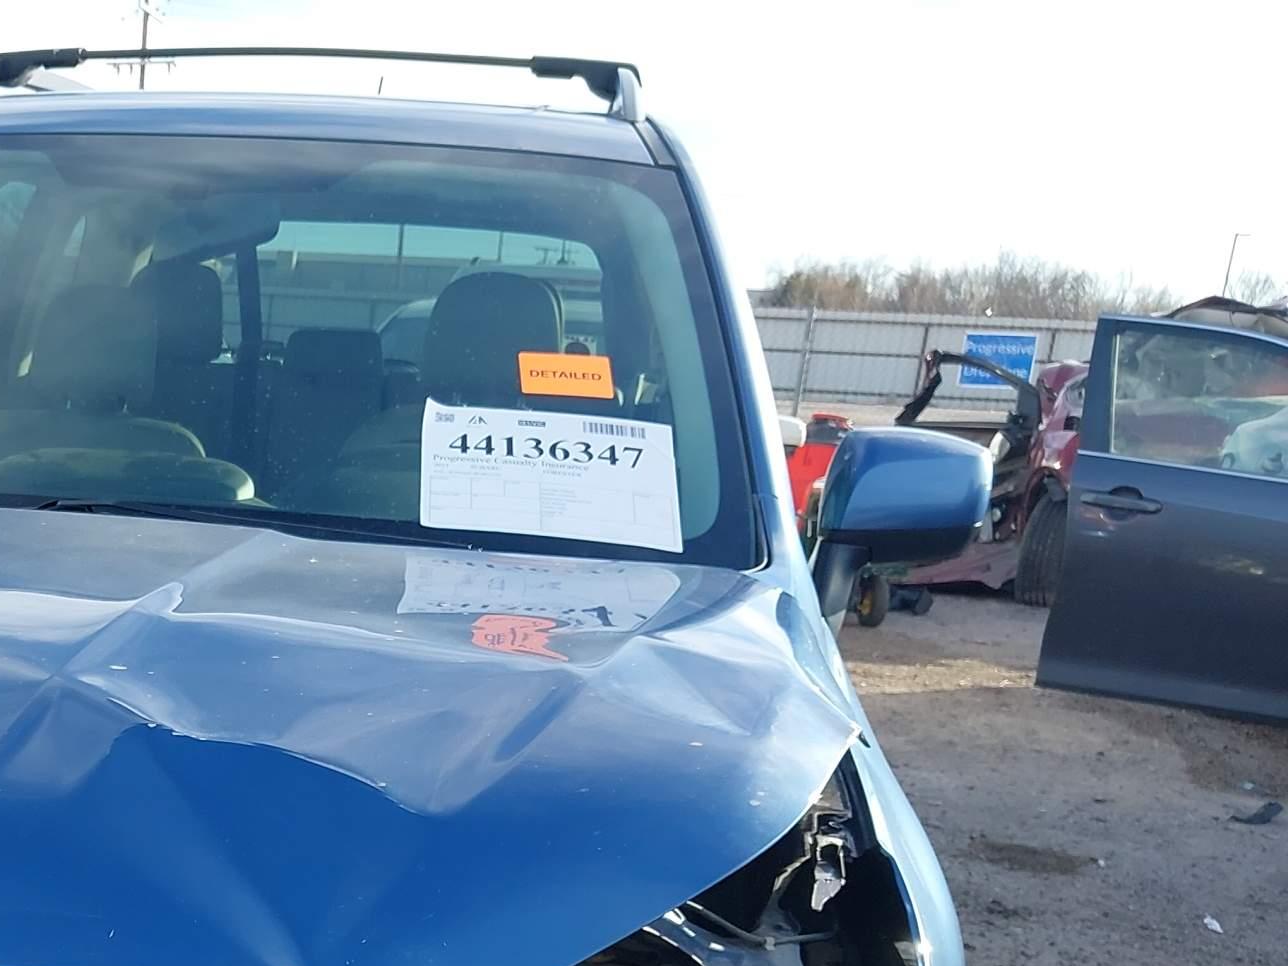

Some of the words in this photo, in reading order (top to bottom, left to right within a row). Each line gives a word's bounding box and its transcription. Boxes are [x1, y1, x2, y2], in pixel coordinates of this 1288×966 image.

[966, 341, 1034, 356] Progressive
[529, 369, 602, 381] DETAILED
[449, 433, 644, 468] 44136347
[433, 454, 491, 464] Progressive
[494, 458, 538, 468] Casualty
[541, 460, 589, 471] Insurance
